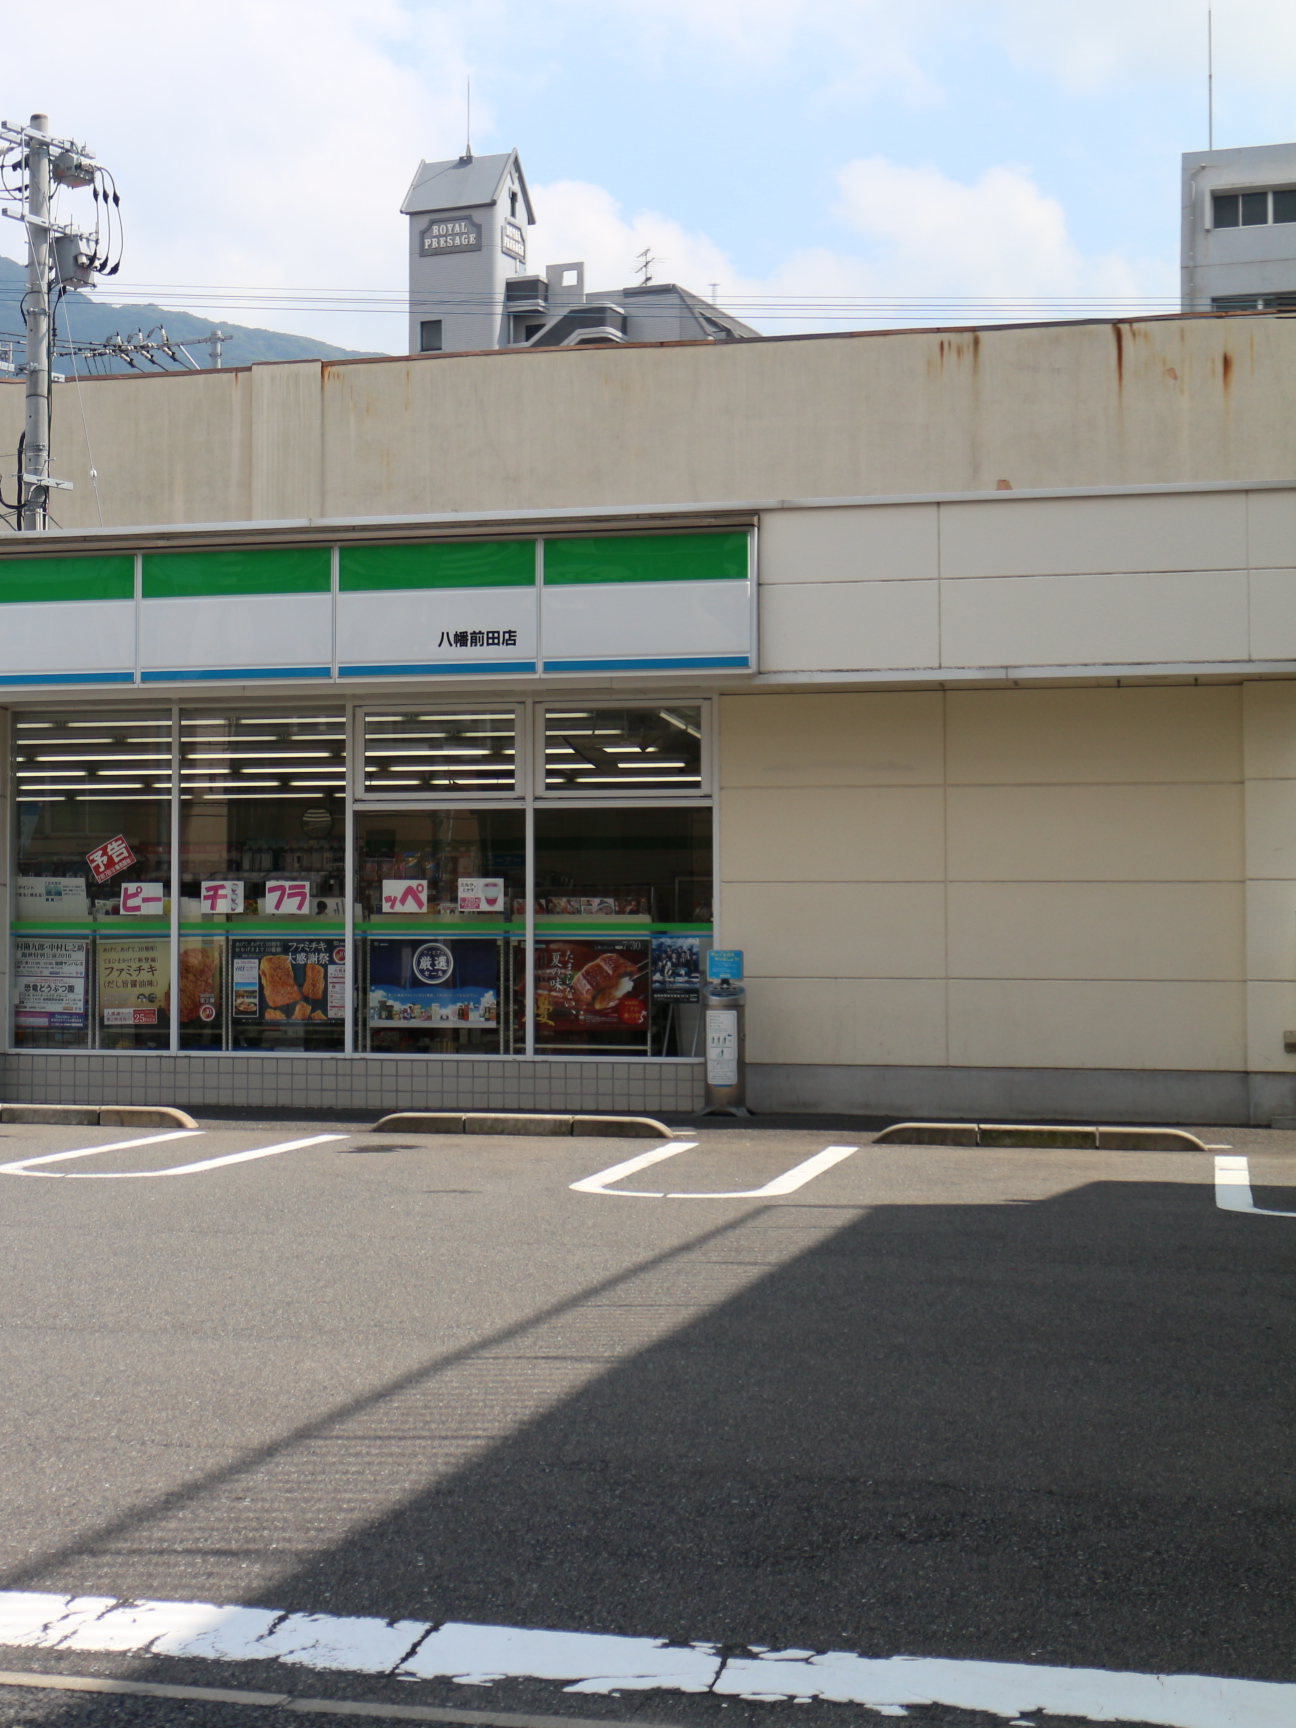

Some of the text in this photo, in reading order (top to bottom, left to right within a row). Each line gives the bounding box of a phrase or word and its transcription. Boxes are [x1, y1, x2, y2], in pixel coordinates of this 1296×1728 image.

[432, 222, 468, 236] ROYAL
[424, 233, 477, 250] PRESAGE
[437, 629, 518, 648] 八幡前田店
[89, 839, 126, 872] 予告
[267, 884, 307, 912] フラ
[288, 941, 327, 952] ファミチキ
[286, 952, 330, 965] 大感謝祭
[418, 955, 449, 971] 厳選
[104, 963, 158, 978] ファミチキ
